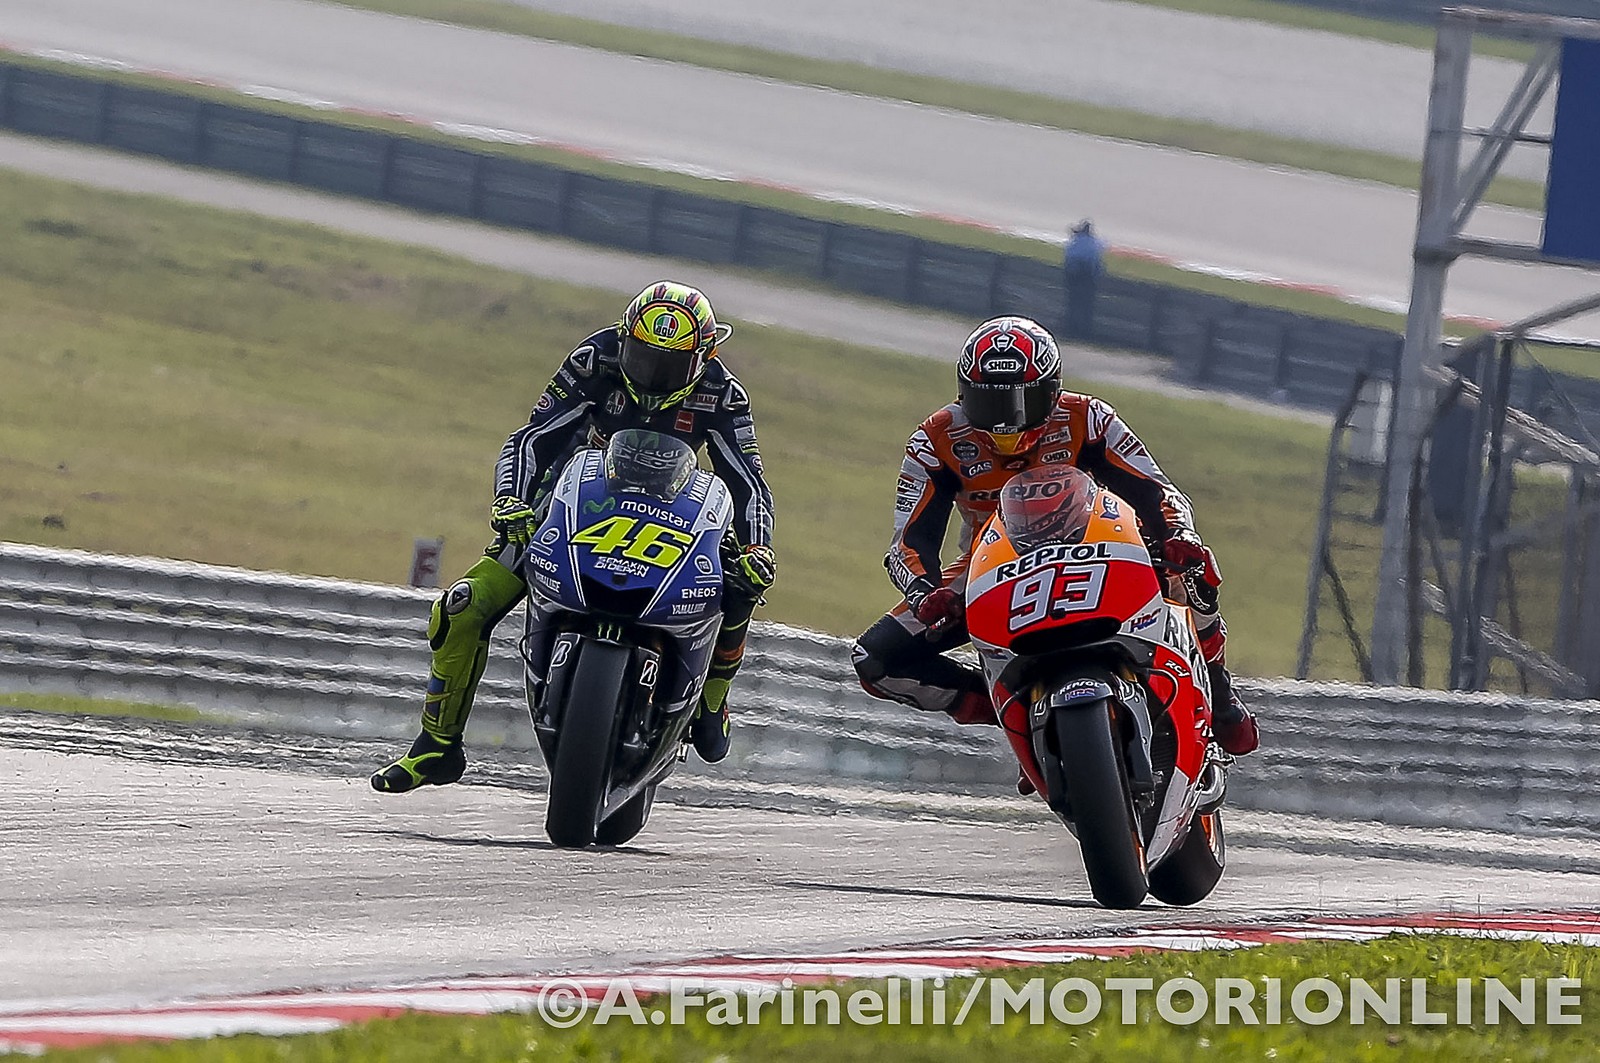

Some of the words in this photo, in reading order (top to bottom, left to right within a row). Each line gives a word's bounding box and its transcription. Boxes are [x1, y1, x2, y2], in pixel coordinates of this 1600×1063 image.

[988, 360, 1017, 371] SHOEI
[970, 381, 989, 390] GIVES
[993, 383, 1011, 391] YOU
[1014, 380, 1040, 390] WINGS
[968, 461, 992, 476] GAS
[620, 500, 690, 529] movistar
[571, 516, 694, 568] 46
[530, 553, 559, 573] ENEOS
[995, 543, 1112, 584] REPSOL
[681, 587, 717, 599] ENEOS
[1009, 563, 1107, 631] 93
